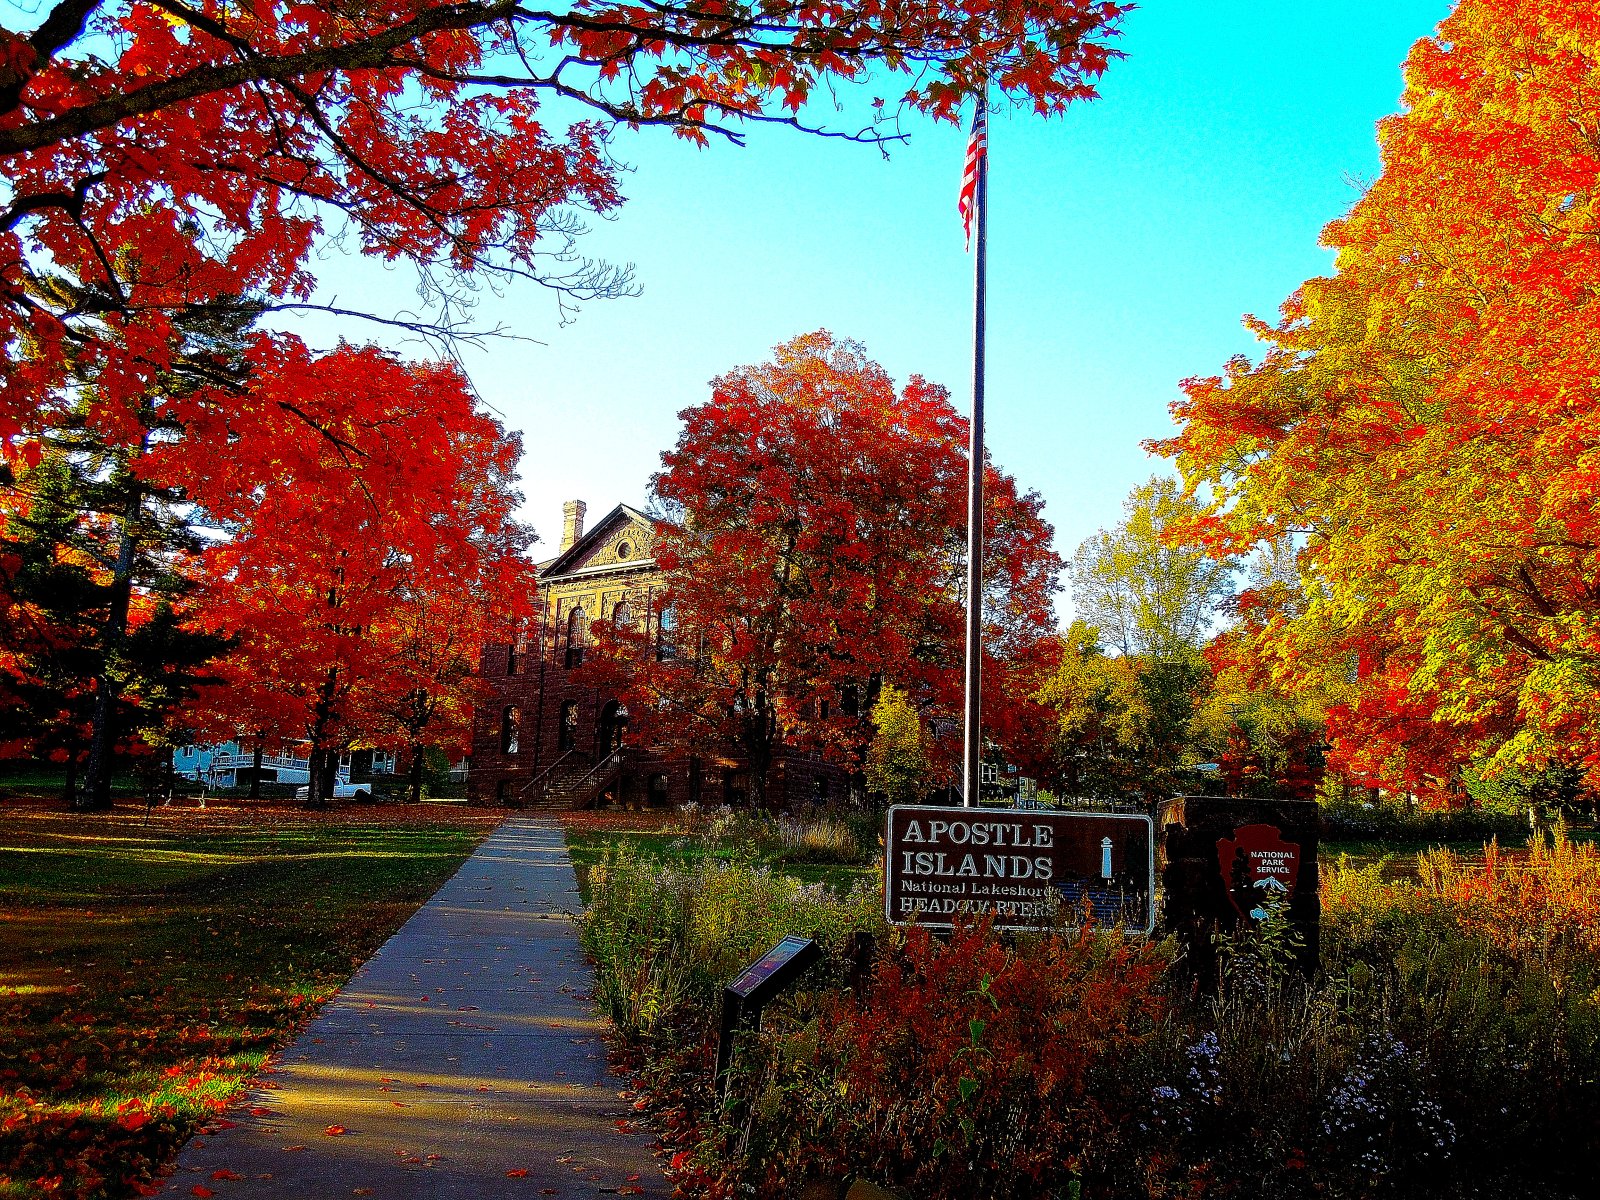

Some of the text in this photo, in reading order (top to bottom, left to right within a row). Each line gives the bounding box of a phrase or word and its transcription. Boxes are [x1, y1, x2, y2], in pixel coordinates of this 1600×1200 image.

[902, 820, 1053, 848] APOSTLE
[1251, 851, 1295, 859] NATIONAL
[901, 851, 1053, 879] ISLANDS
[1256, 866, 1290, 874] SERVICE
[901, 880, 966, 894] National
